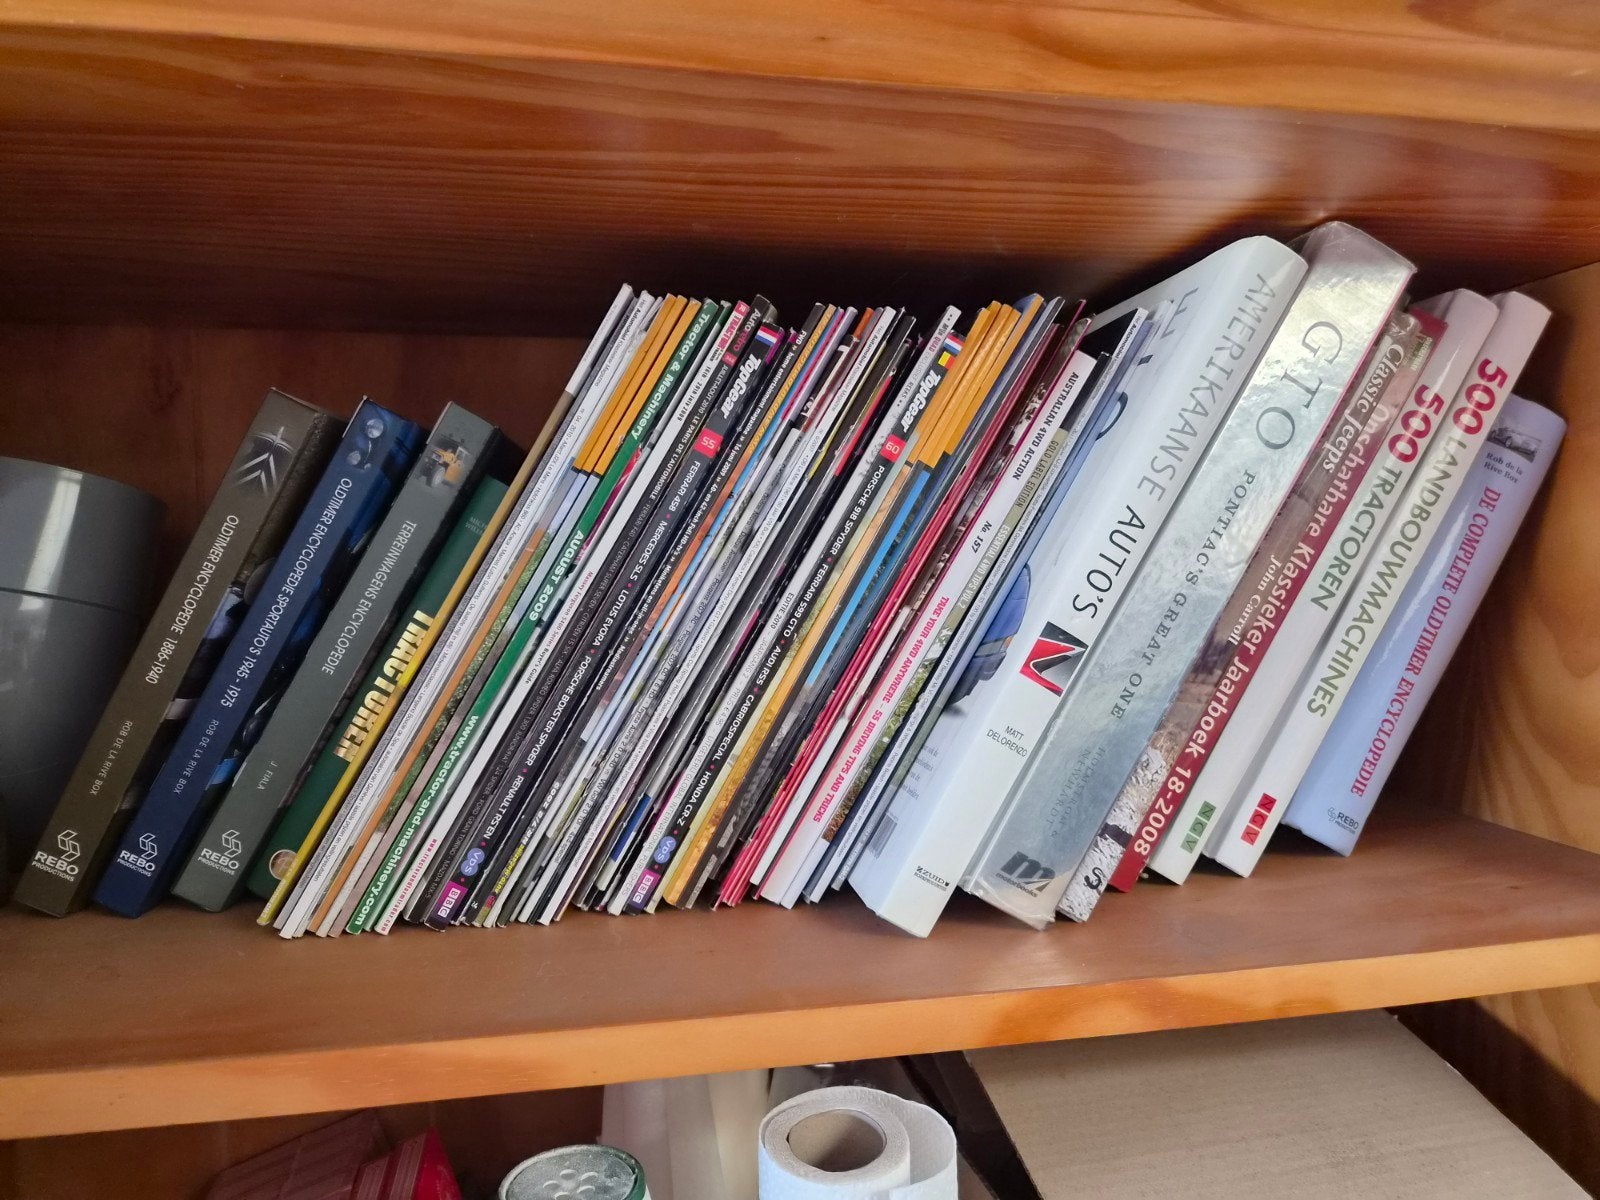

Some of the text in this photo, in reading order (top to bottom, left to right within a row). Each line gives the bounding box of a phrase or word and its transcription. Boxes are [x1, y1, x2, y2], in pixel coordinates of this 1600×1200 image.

[620, 307, 641, 340] Automobiel
[794, 329, 807, 345] FWD
[628, 310, 710, 441] Tractor & Machinery
[780, 351, 794, 368] home
[714, 351, 762, 421] TopGear
[757, 366, 784, 408] entertainment
[896, 367, 942, 434] TopGear
[1256, 320, 1344, 450] GTO
[691, 415, 699, 424] LE
[697, 399, 709, 414] 2010
[741, 406, 761, 435] magazine
[1313, 338, 1408, 476] Classic Jeeps
[680, 423, 695, 443] PARIS
[1011, 370, 1079, 481] AUSTRALIAN 4WD ACTION
[674, 443, 684, 454] DE
[699, 435, 716, 450] 55
[726, 449, 737, 462] juni
[733, 442, 741, 451] 16
[1072, 273, 1277, 620] AMERIKAANSE AUTO'S
[648, 453, 678, 500] L'AUTOMOBILE
[676, 459, 701, 496] FERRARI
[718, 461, 730, 476] 2009
[1014, 438, 1059, 508] GOLD LABEL EDITION
[1484, 462, 1518, 484] Rive Box
[1486, 452, 1515, 470] Rob de
[857, 464, 885, 506] PORSCHE
[1310, 384, 1444, 612] 500 TRACTOREN
[633, 502, 650, 526] FERRARI
[667, 494, 682, 512] 458
[691, 500, 708, 524] 42-inch
[849, 505, 861, 520] 918
[637, 519, 667, 565] MERCEDES
[684, 522, 696, 535] Full
[828, 519, 853, 556] SPYDER
[969, 520, 993, 553] No. 157
[985, 523, 1010, 559] ESSENTIAL
[1301, 358, 1508, 719] 500 LANDBOUWMACHINES
[607, 540, 629, 573] CATERHAM
[628, 563, 643, 581] SLS
[976, 556, 992, 575] 4WD
[528, 528, 584, 622] AUGUST 2009
[597, 571, 611, 590] SUPER
[802, 562, 828, 602] FERRARI
[967, 573, 982, 590] TIPS
[143, 512, 239, 685] OLDTIMER ENCYCLOPEDIE 1886-1940
[219, 476, 353, 708] OLDTIMER ENCYCLOPEDIE SPORTAUTO'S 1945 1975
[320, 517, 417, 677] TERREINWAGENS ENCYCLOPEDIE
[587, 589, 601, 608] SEVEN
[608, 588, 629, 618] LOTUS
[1107, 468, 1258, 720] PONTIAC'S GREAT ONE
[1225, 553, 1284, 647] John Carroll
[1237, 540, 1317, 660] Klassieker
[769, 591, 794, 630] EDITIE 2010
[792, 600, 807, 618] 599
[524, 569, 593, 685] Massey Ferguson Series Buyer's Guide
[591, 616, 613, 647] EVORA
[782, 616, 798, 638] GTO
[1345, 485, 1502, 798] DE COMPLETE OLDTIMER ENCYCLOPEDIE
[594, 643, 626, 692] Mediastreamers
[764, 644, 782, 668] AUDI
[564, 654, 592, 695] PORSCHE
[543, 693, 570, 734] BOXSTER
[812, 594, 949, 823] TAKE YOUR 4WD ANYWHERE 55 DRIVING TIPS AND TRICKS
[1181, 655, 1253, 761] Jaarboek
[710, 692, 754, 763] CABRIOSPECIAL
[986, 729, 1028, 758] DELORENZO
[1005, 725, 1024, 740] MATT
[88, 719, 133, 796] ROB DE LA RIVE BOX
[172, 718, 219, 795] ROB DE LA RIVE BOX
[523, 731, 548, 766] SPYDER
[255, 760, 278, 791] J. FIALA
[688, 770, 712, 804] HONDA
[470, 797, 484, 815] FORD
[496, 773, 524, 814] RENAULT
[1128, 761, 1196, 859] 18-2008
[350, 711, 480, 927] www.tractor-and-machinery.com
[461, 814, 475, 833] GRAN
[675, 802, 693, 827] CR-Z
[1182, 804, 1213, 851] NGV
[1243, 796, 1273, 843] NGV
[1337, 812, 1359, 829] REBO
[34, 851, 79, 875] REBO
[119, 850, 156, 872] REBO
[198, 857, 235, 875] PRODUCTIONS
[200, 849, 239, 870] REBO
[463, 849, 481, 874] VDS
[656, 838, 673, 861] VDS
[31, 861, 74, 881] PRODUCTIONS
[116, 858, 151, 877] PRODUCTIONS
[620, 853, 648, 897] PUBLISHERS
[436, 886, 460, 918] BBC
[631, 873, 653, 904] BBC
